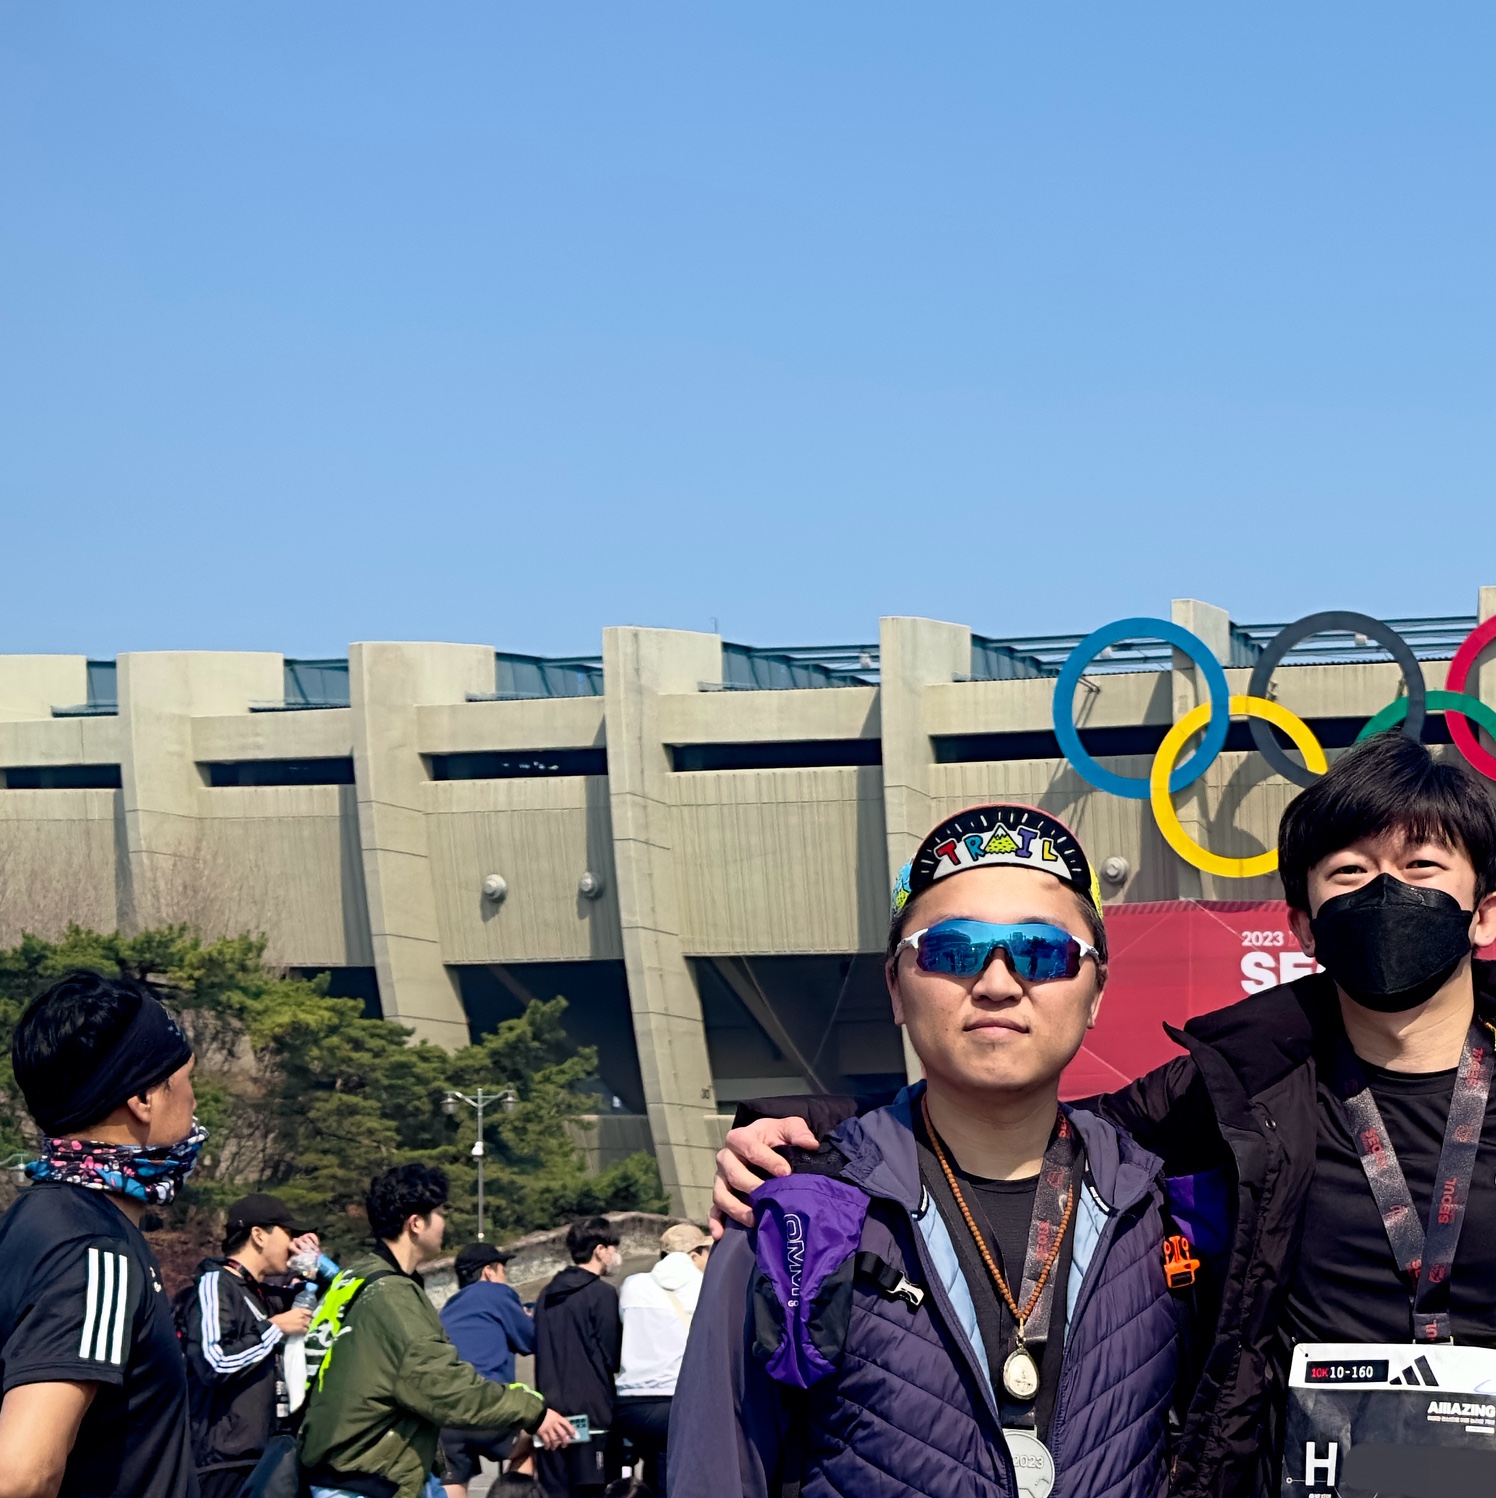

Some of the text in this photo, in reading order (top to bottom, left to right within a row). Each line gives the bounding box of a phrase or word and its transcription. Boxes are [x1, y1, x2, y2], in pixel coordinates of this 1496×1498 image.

[934, 822, 1059, 866] TRAIL
[1241, 930, 1285, 947] 2023
[1240, 950, 1327, 995] SE
[1437, 1176, 1457, 1225] SEOUL
[1310, 1364, 1374, 1380] 10K 10-160
[1426, 1400, 1496, 1418] AMAZING
[1012, 1453, 1045, 1470] 2023
[1304, 1440, 1339, 1487] H
